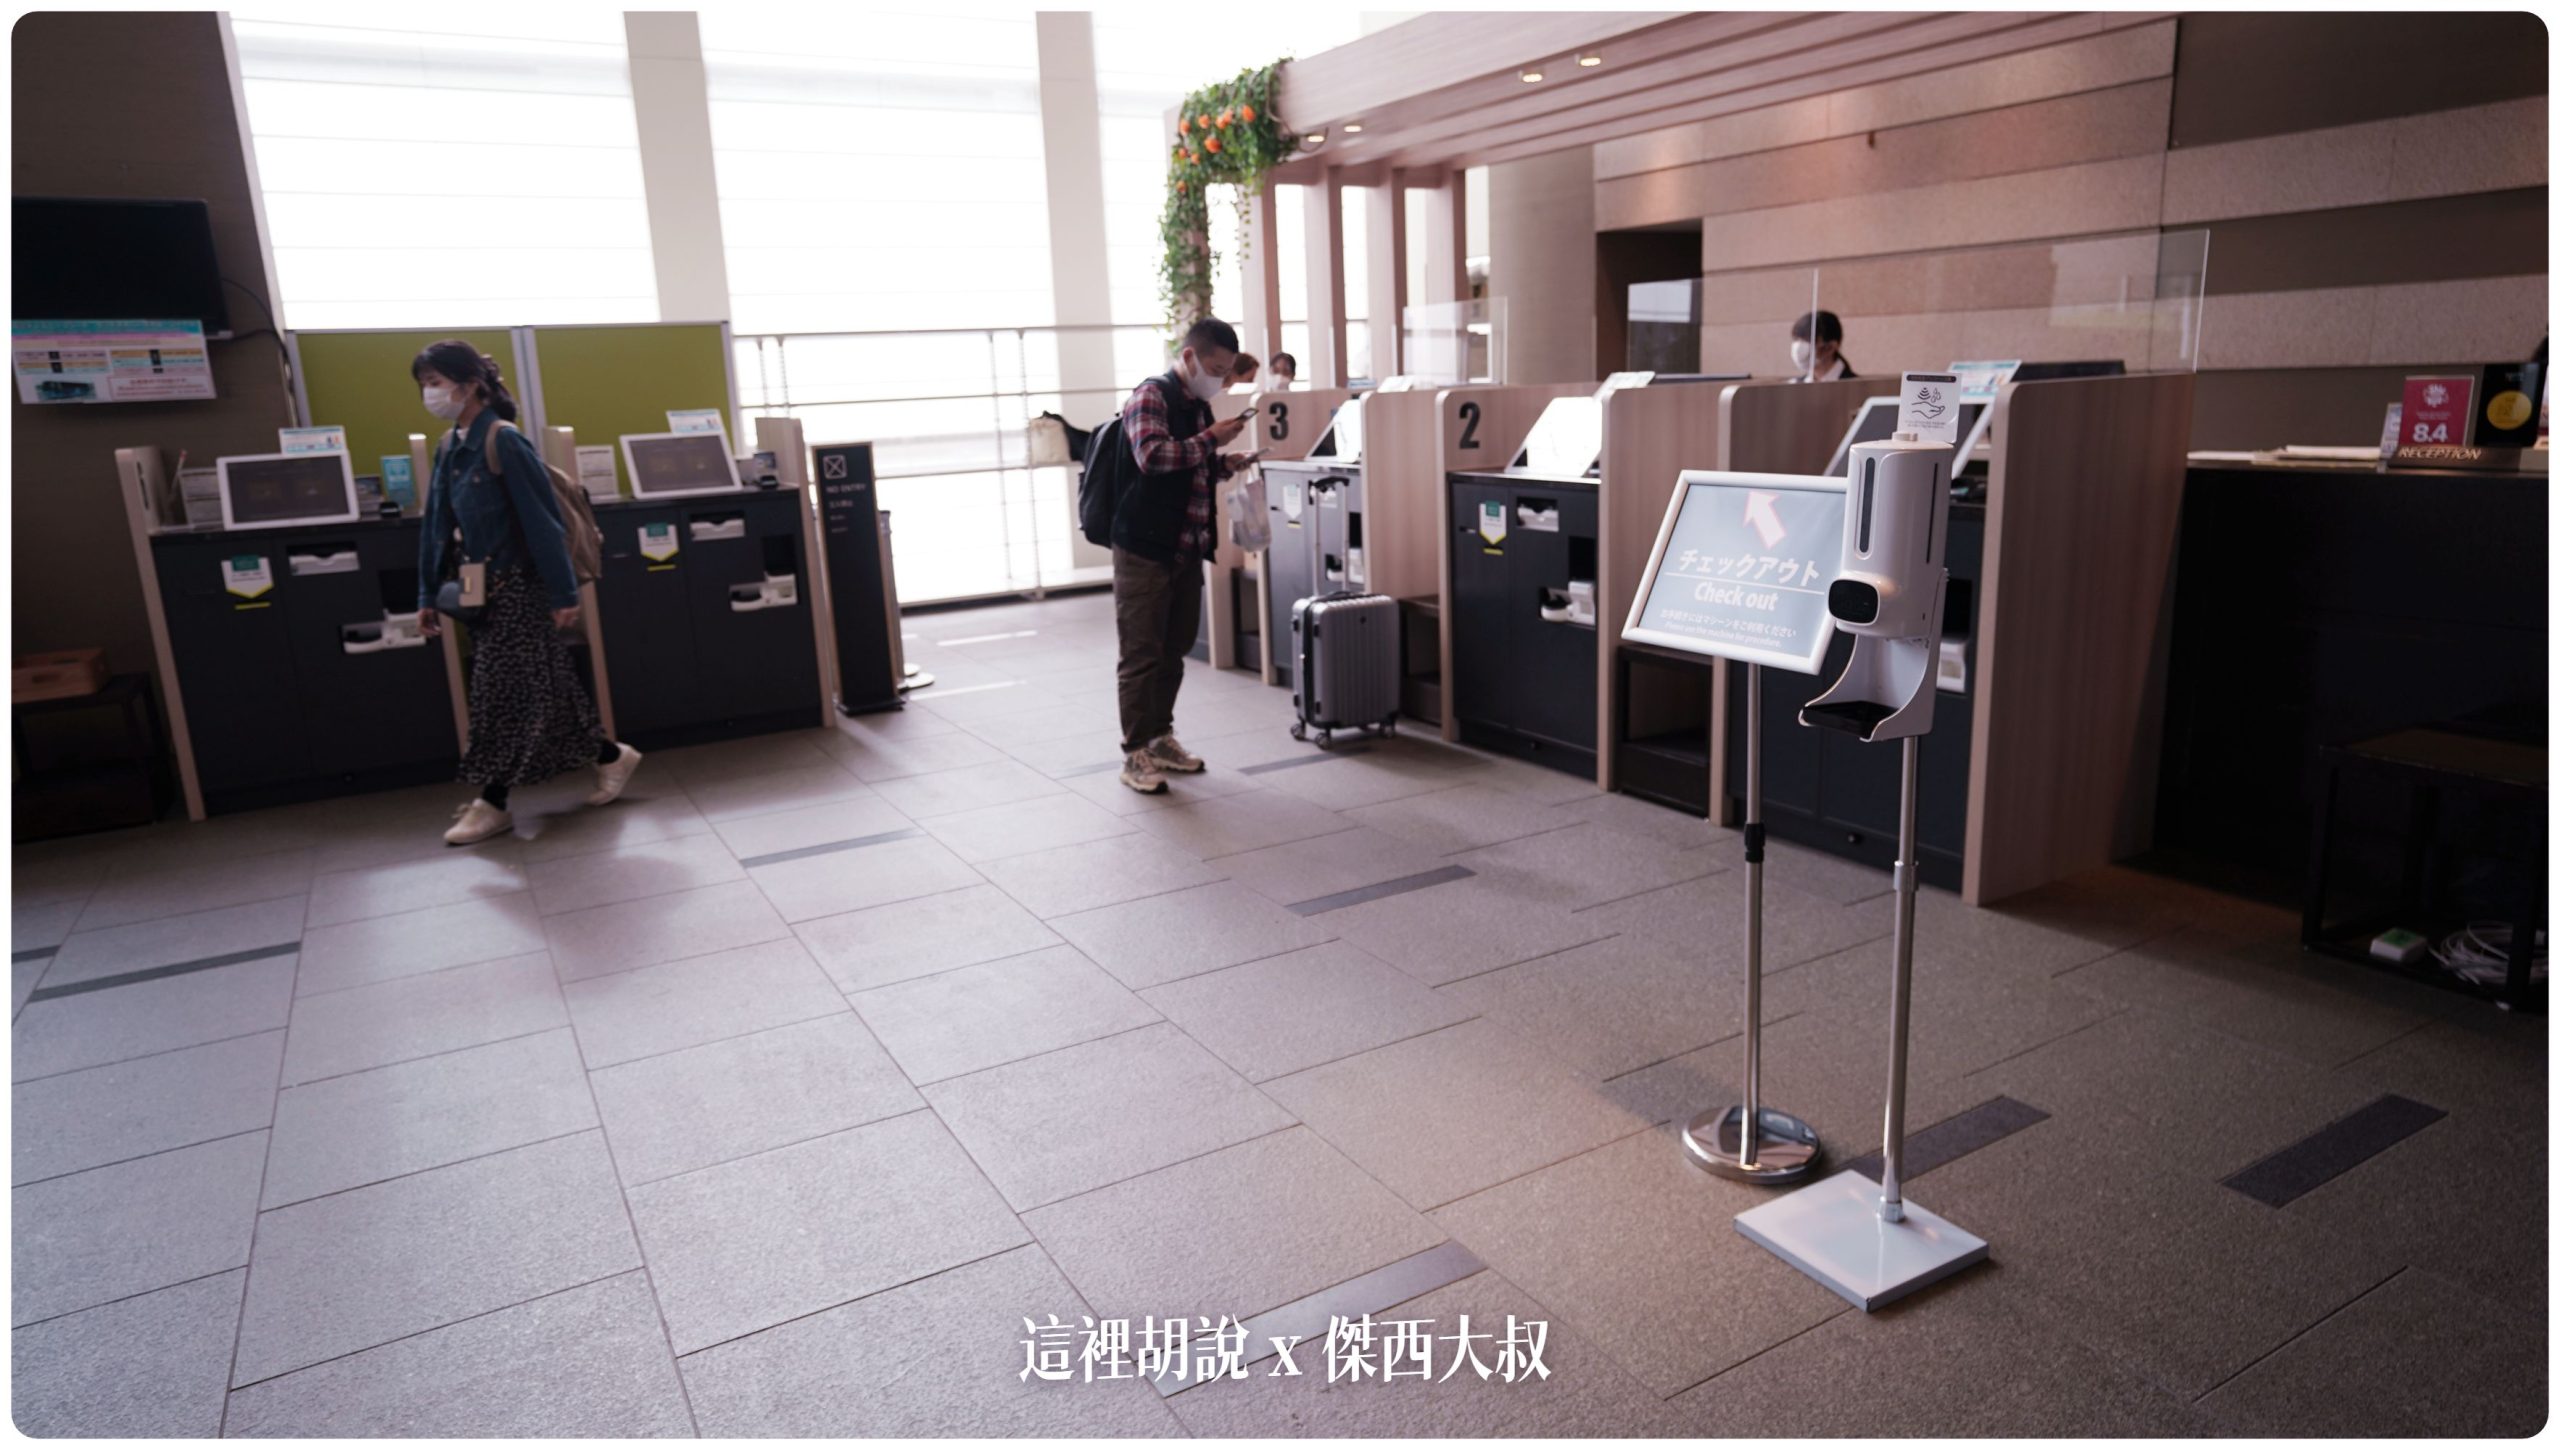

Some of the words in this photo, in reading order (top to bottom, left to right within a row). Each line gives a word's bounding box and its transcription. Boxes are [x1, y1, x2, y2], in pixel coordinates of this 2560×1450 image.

[1268, 402, 1289, 441] 3
[1458, 402, 1481, 450] 2
[2412, 422, 2449, 443] 8.4
[2398, 447, 2482, 460] RECEPTION
[1679, 549, 1820, 587] チェックアウト
[1694, 581, 1745, 607] Check
[1745, 592, 1779, 611] out
